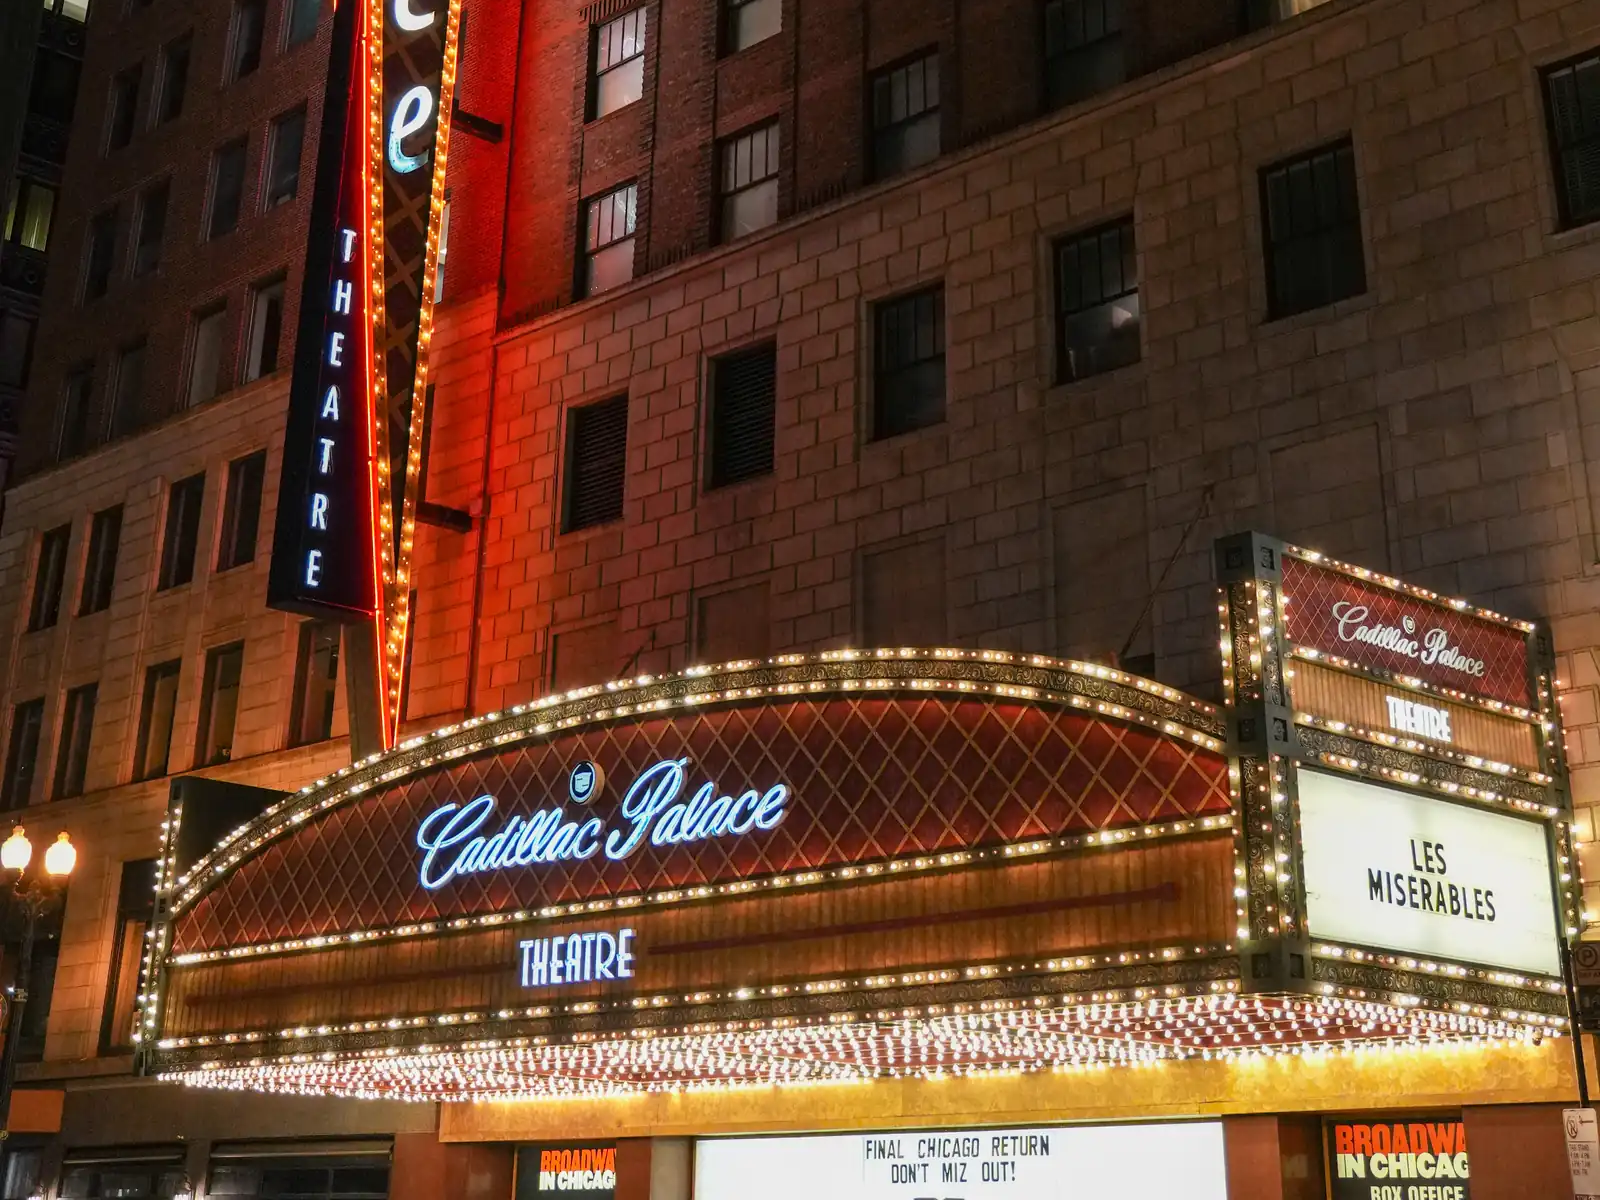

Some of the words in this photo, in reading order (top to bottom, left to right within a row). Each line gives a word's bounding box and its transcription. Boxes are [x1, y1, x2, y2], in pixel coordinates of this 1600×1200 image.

[306, 228, 357, 587] THEATRE
[1332, 601, 1418, 658] Cadillac
[1421, 628, 1484, 677] Palace
[1386, 696, 1451, 742] THEATRE
[416, 794, 603, 890] Cadillac
[605, 756, 790, 860] Palace
[1410, 839, 1447, 875] LES
[519, 928, 637, 987] THEATRE
[540, 1148, 617, 1173] BROADWA
[866, 1139, 905, 1159] FINAL
[918, 1138, 980, 1158] CHICAGO
[992, 1135, 1050, 1156] RETURN
[539, 1171, 555, 1190] IN
[557, 1170, 616, 1190] CHICAG
[891, 1163, 929, 1184] DON'T
[942, 1162, 968, 1183] MIZ
[981, 1161, 1016, 1182] OUT!
[1336, 1153, 1366, 1178] IN
